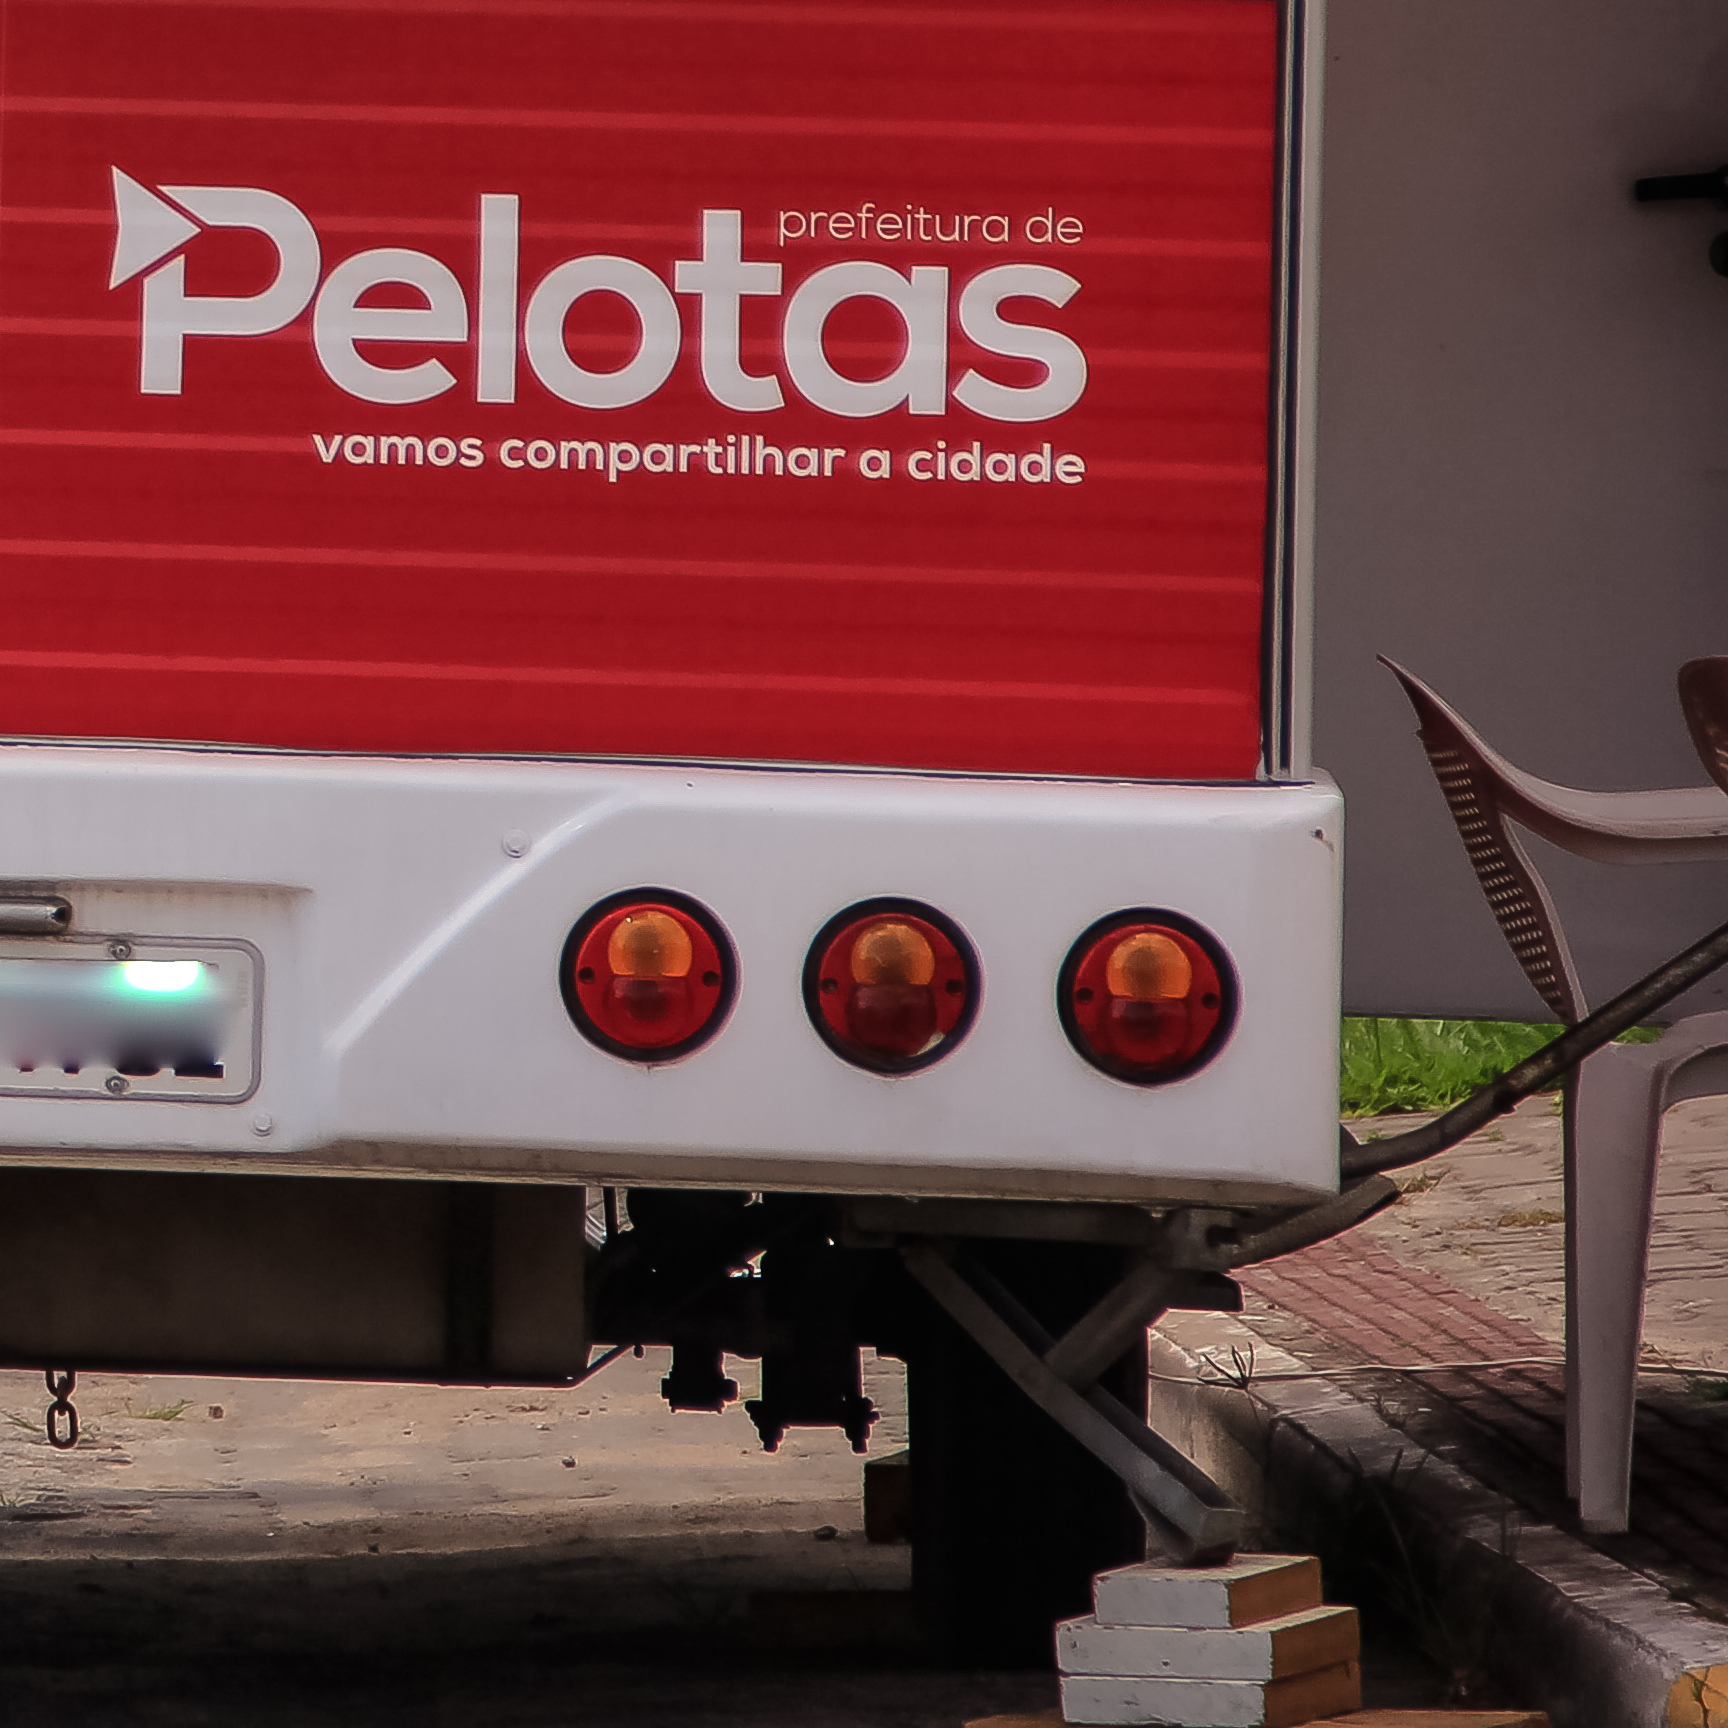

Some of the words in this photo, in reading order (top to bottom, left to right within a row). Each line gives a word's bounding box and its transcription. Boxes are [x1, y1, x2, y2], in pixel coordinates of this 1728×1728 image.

[779, 203, 1009, 247] prefeitura
[1025, 207, 1083, 244] de
[109, 166, 1088, 423] Pelotas
[312, 434, 484, 468] vamos
[500, 434, 847, 483] compartilhar
[859, 449, 891, 479] a
[907, 440, 1086, 484] cidade
